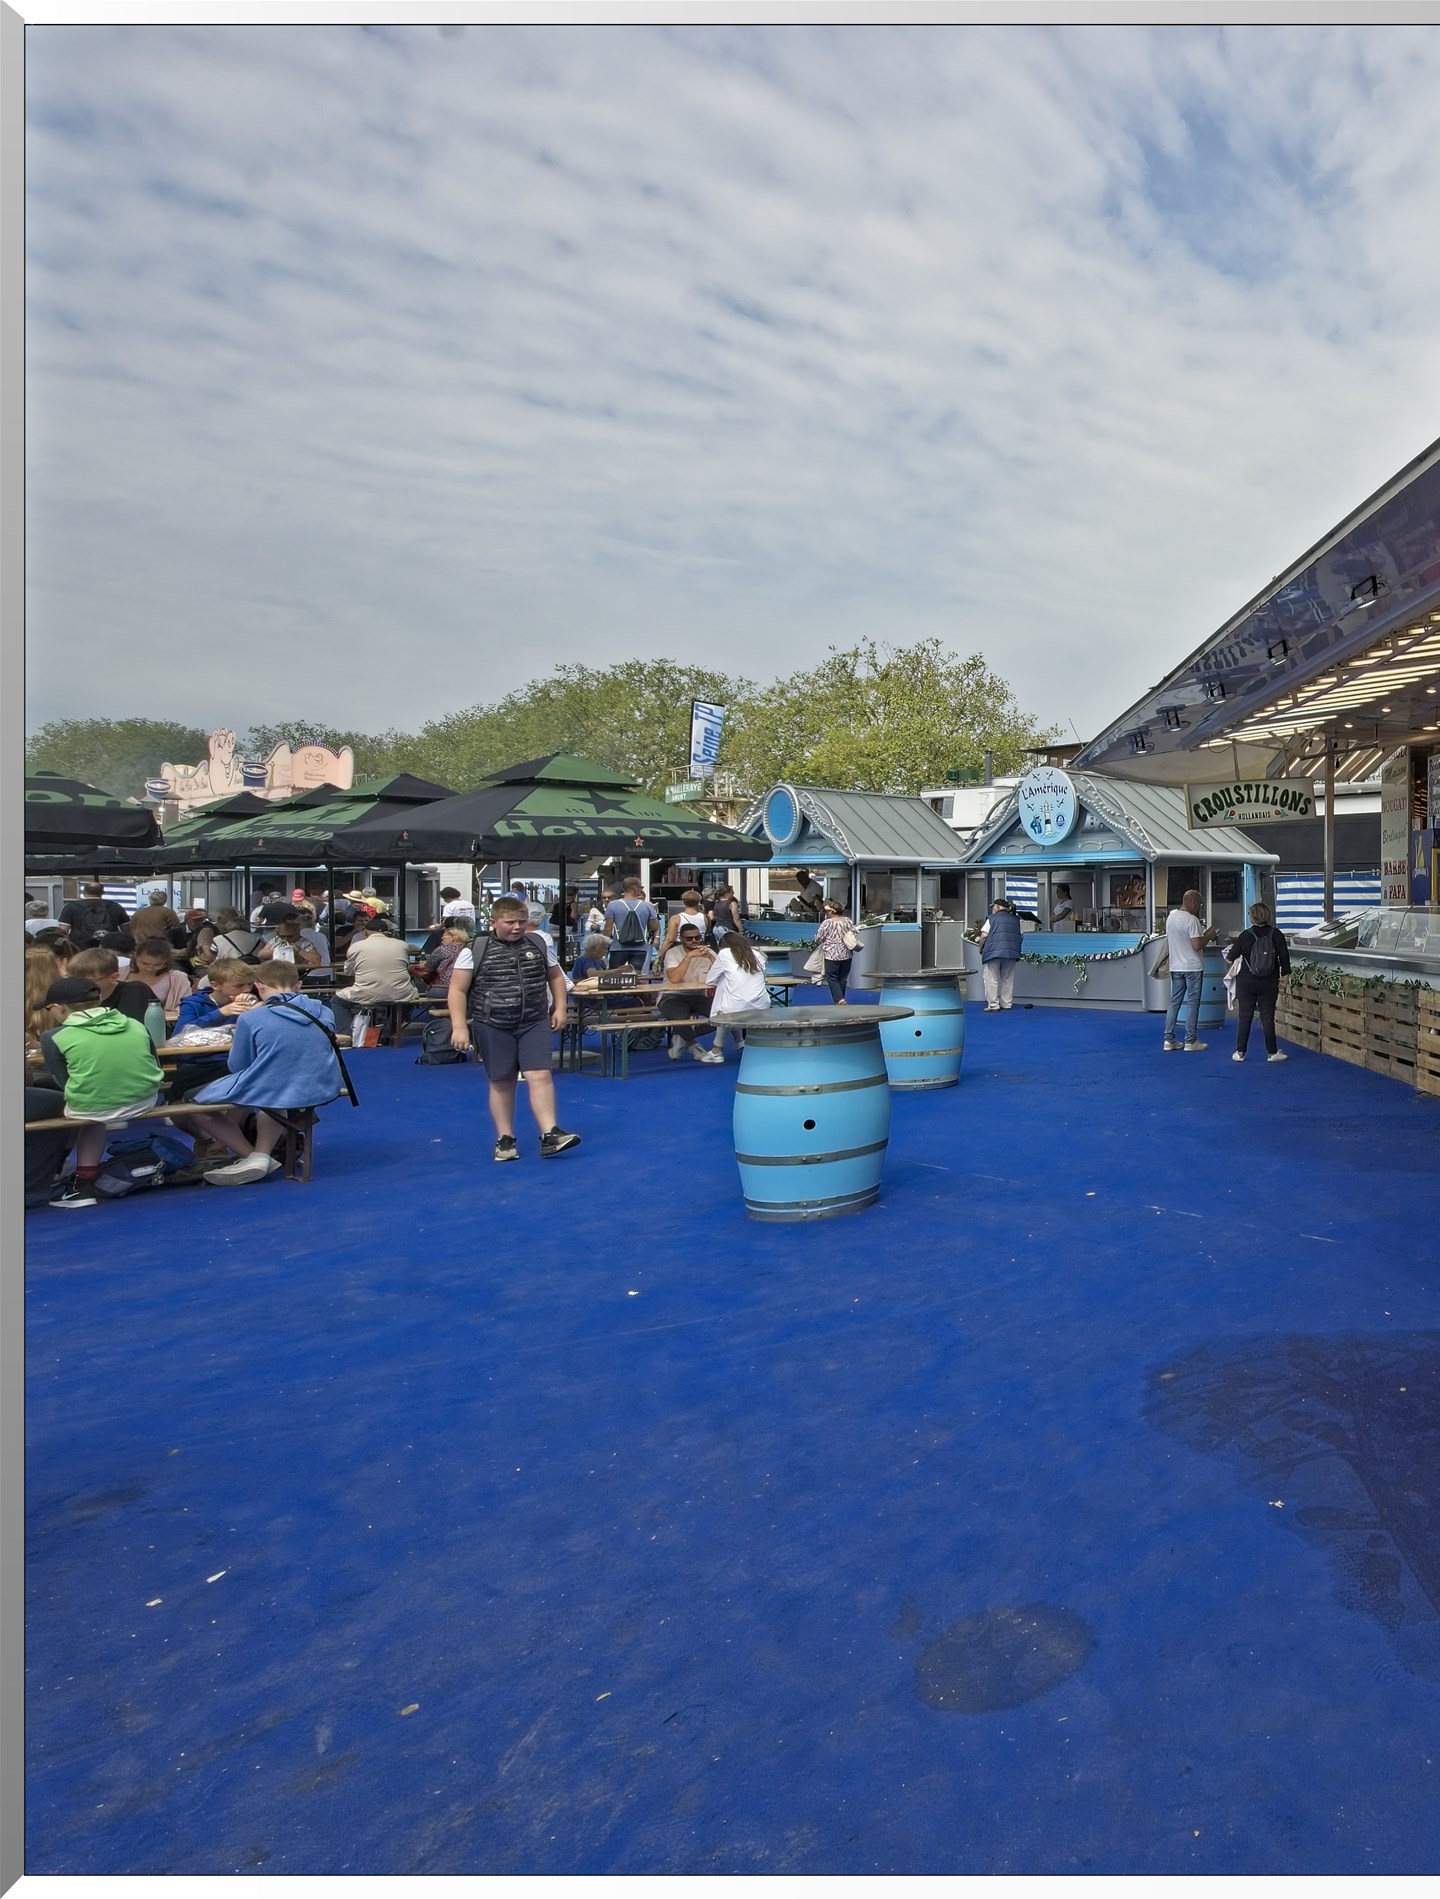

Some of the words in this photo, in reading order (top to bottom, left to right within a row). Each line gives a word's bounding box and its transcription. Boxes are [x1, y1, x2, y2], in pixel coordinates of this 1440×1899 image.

[692, 727, 721, 764] Seine
[1021, 783, 1068, 800] L'Amérique
[1193, 784, 1311, 822] CROUSTILLONS
[1238, 811, 1270, 820] HOLLANDAIS
[1384, 861, 1406, 875] BARBE
[1389, 885, 1406, 899] PAPA
